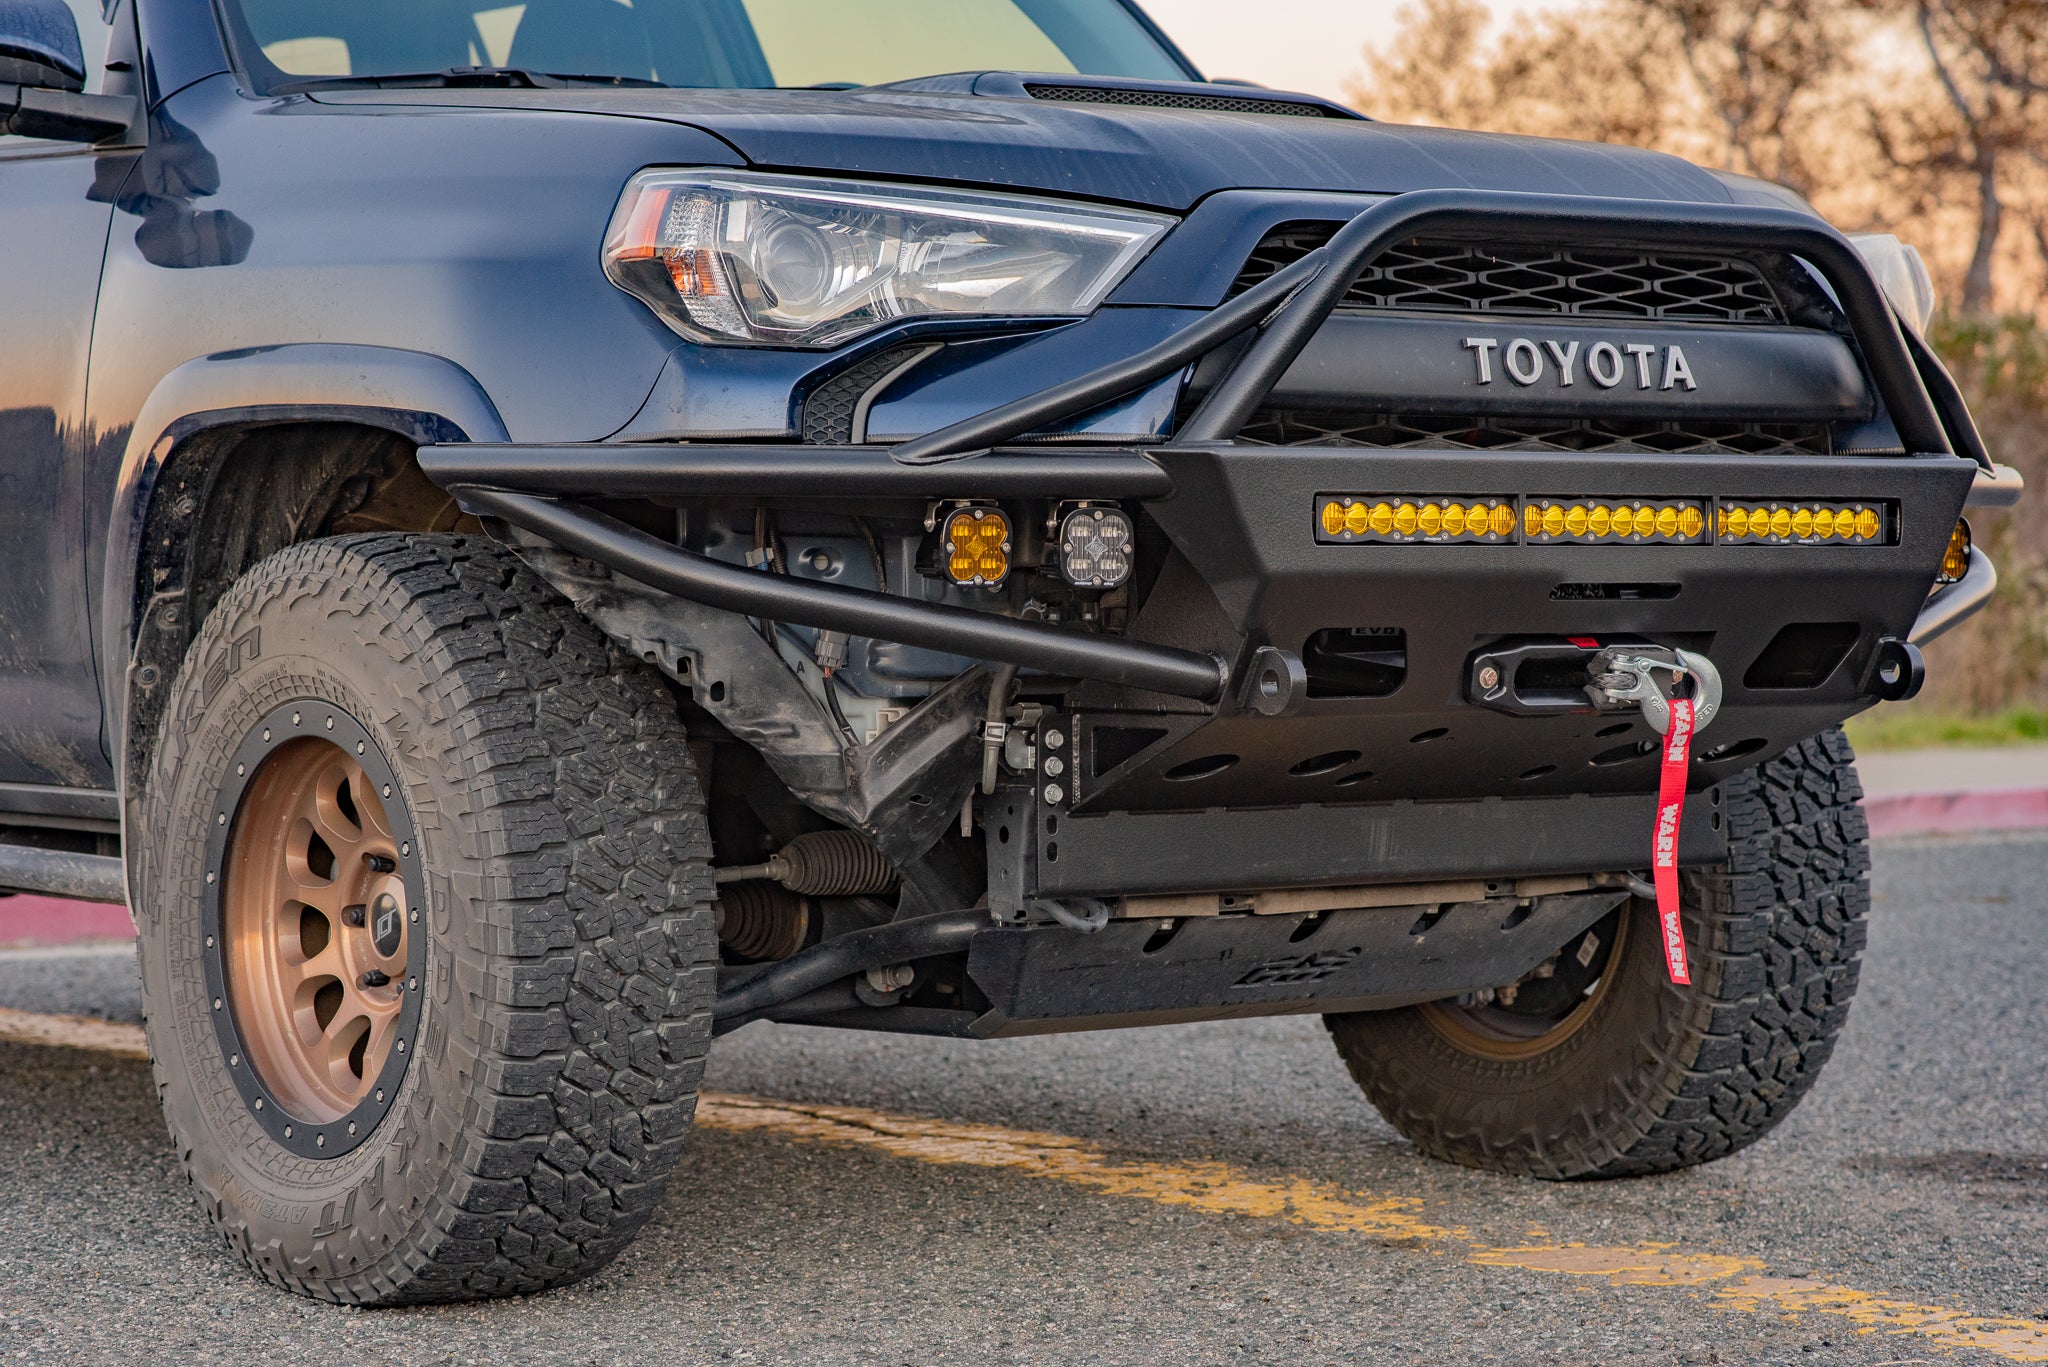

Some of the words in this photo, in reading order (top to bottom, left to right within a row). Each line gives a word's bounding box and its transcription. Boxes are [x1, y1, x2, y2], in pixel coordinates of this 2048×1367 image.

[1461, 336, 1698, 391] TOYOTA
[1356, 627, 1396, 635] EVO
[796, 660, 806, 674] A
[1667, 700, 1691, 762] WARN
[1657, 803, 1679, 868] WARN
[1664, 910, 1686, 978] WARN
